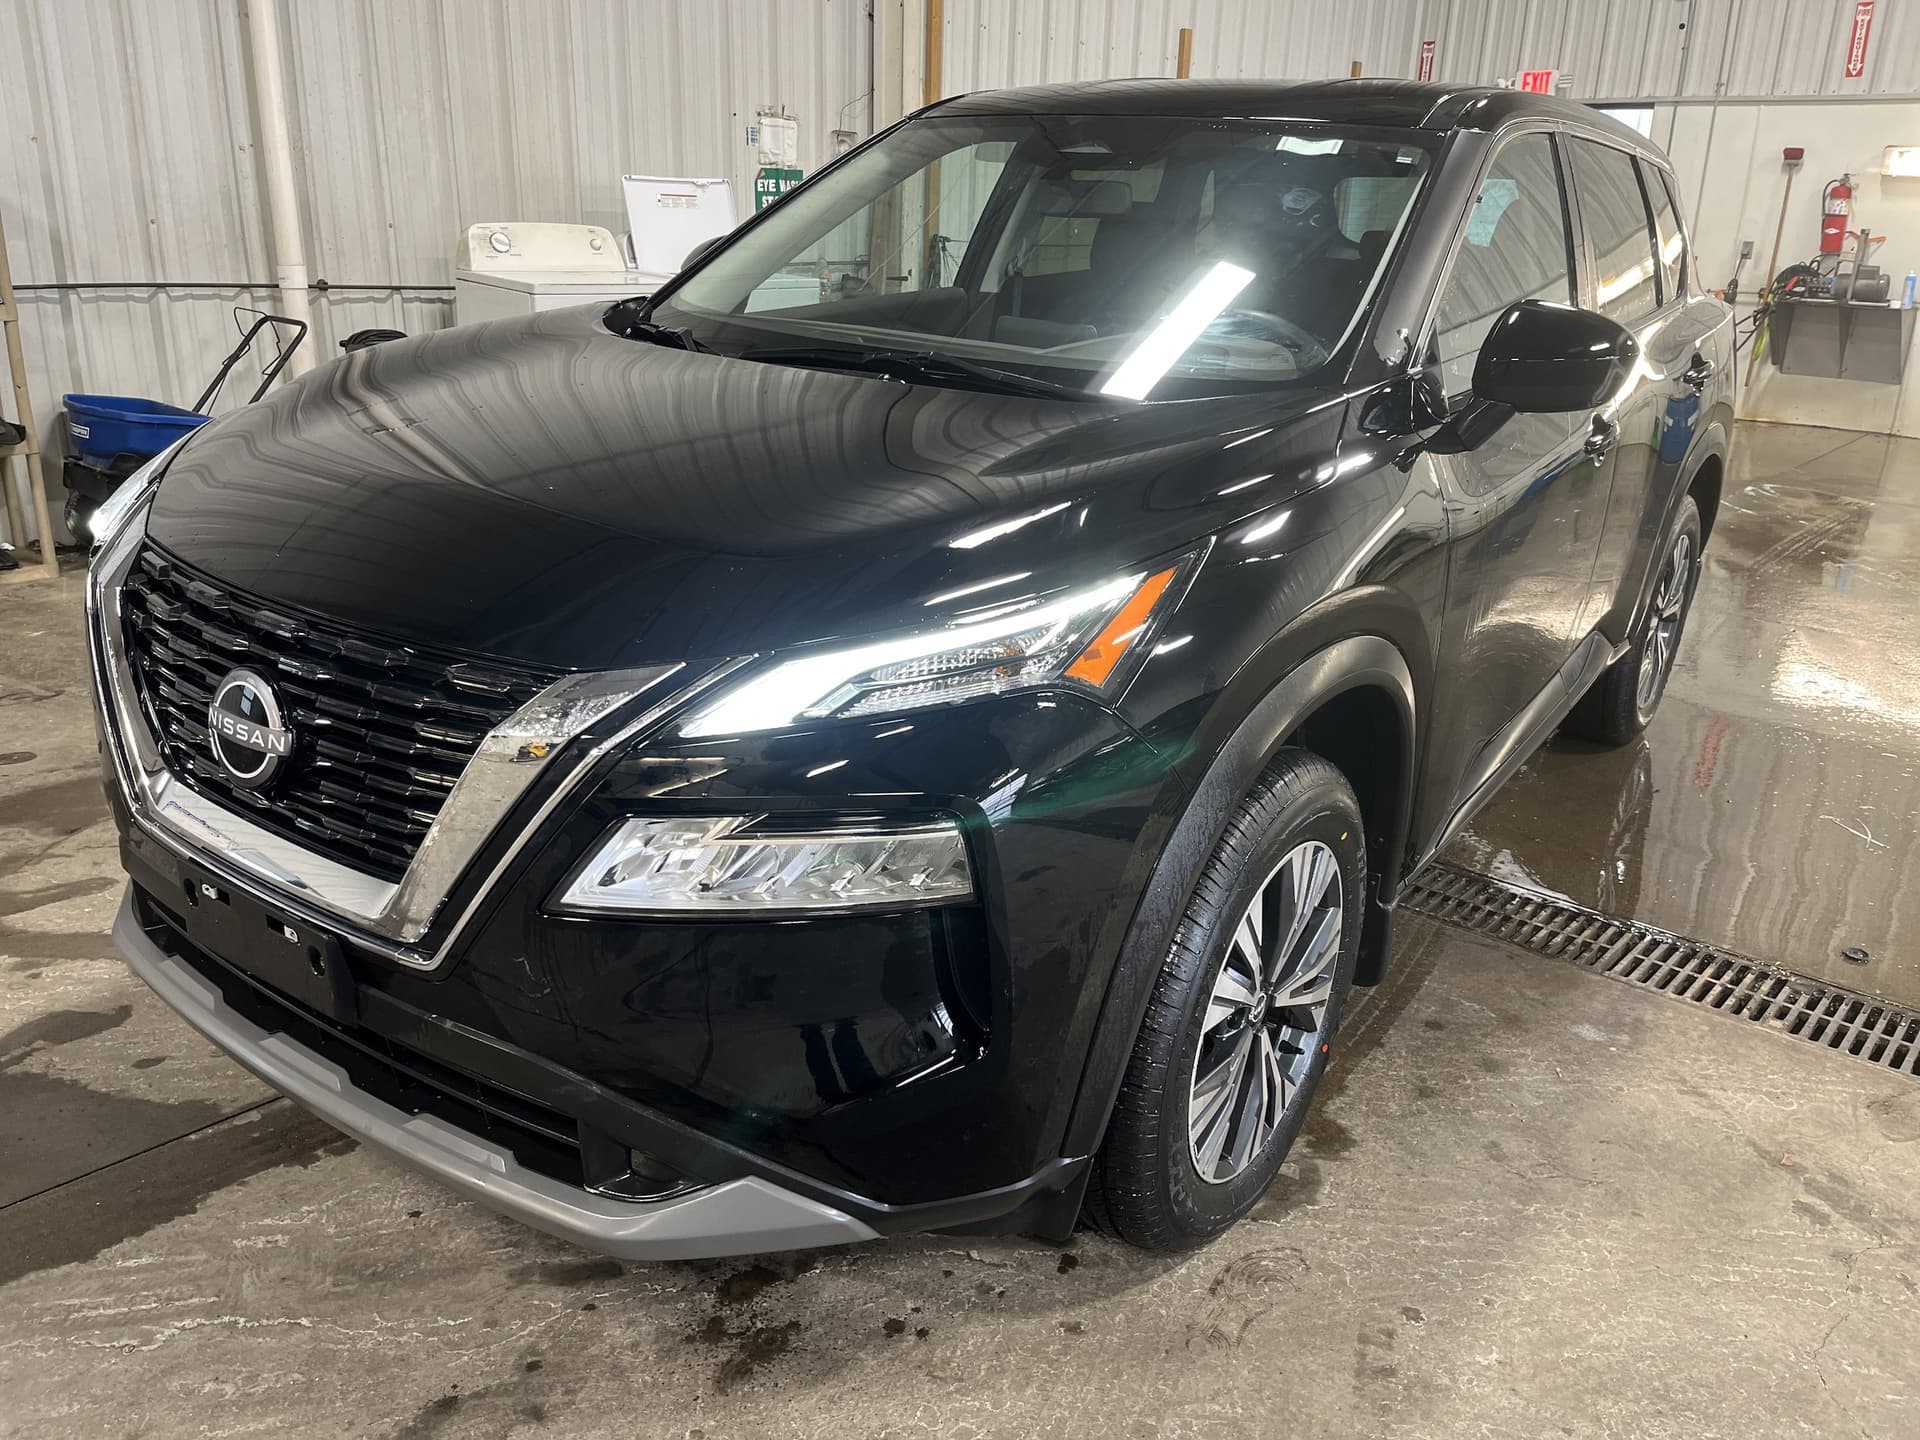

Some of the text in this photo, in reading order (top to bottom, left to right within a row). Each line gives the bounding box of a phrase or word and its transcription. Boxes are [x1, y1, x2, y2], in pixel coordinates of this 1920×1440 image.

[1522, 72, 1552, 94] EXIT
[757, 179, 801, 192] EYE WAS
[208, 704, 285, 752] NISSAN
